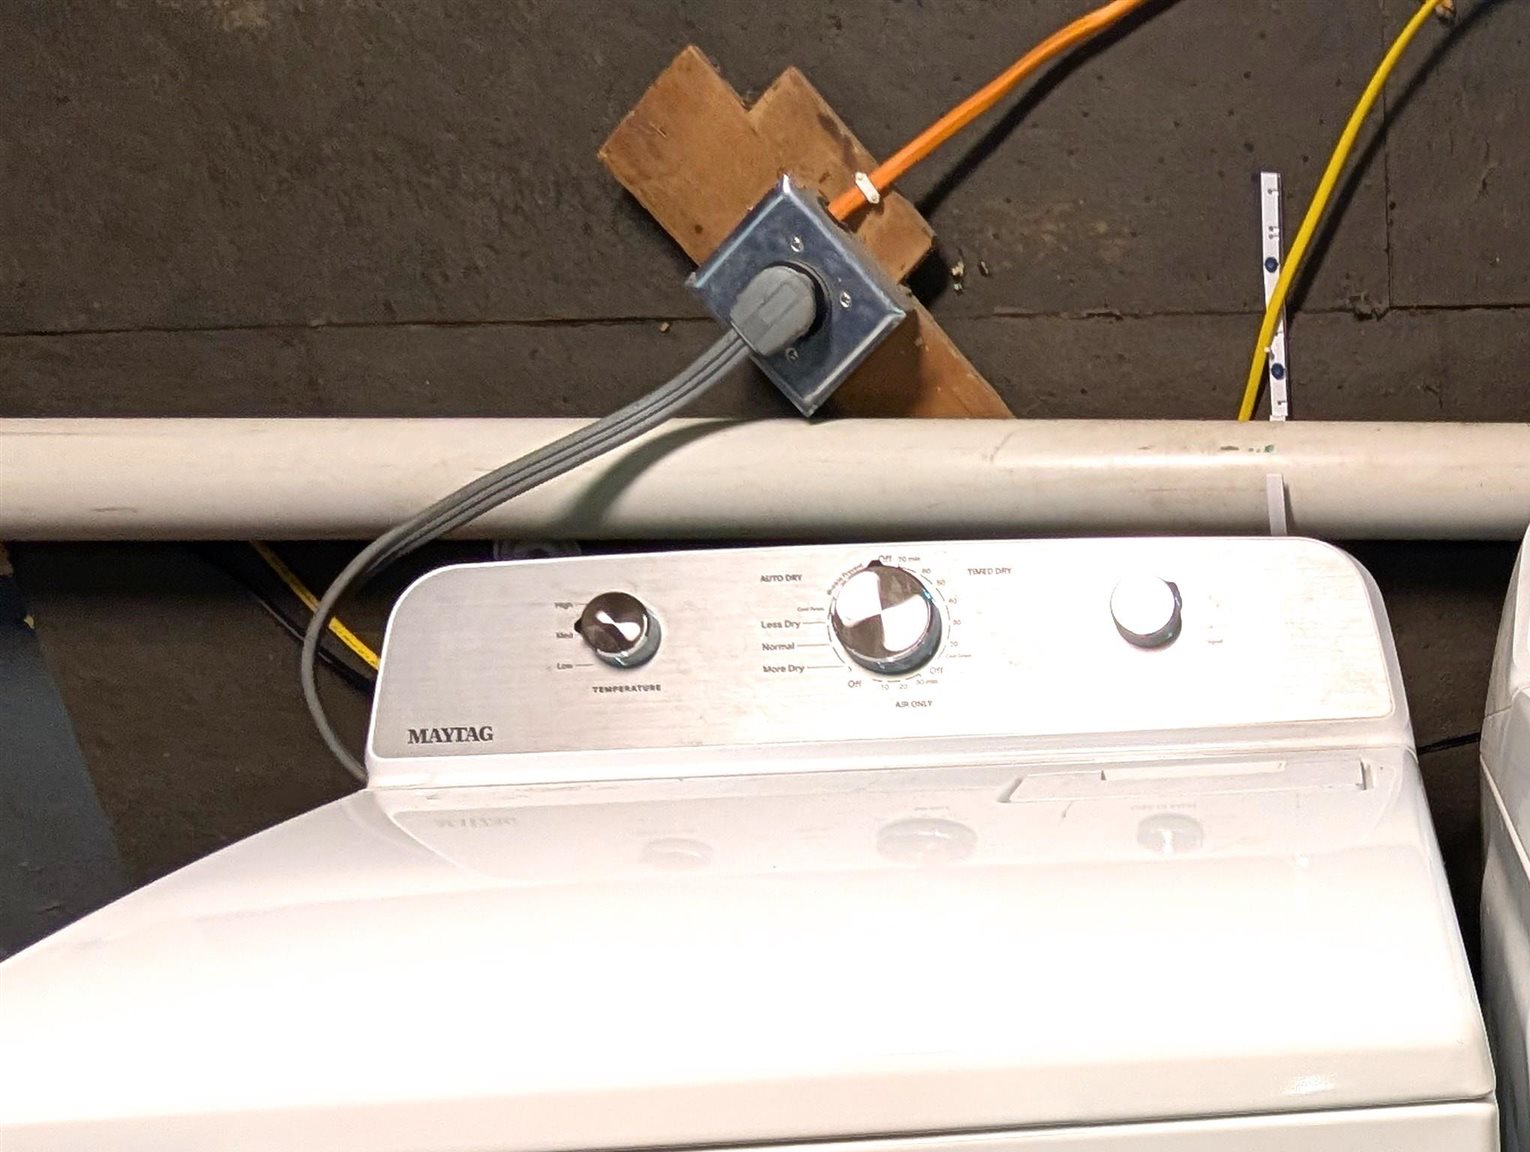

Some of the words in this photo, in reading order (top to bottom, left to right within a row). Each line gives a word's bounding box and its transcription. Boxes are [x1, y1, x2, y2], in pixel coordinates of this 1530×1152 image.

[785, 574, 802, 582] DRY
[761, 621, 783, 629] Less
[784, 620, 801, 629] Dry
[762, 643, 795, 651] Normal
[557, 662, 573, 670] Low
[763, 665, 786, 673] More
[788, 664, 805, 674] Dry
[592, 684, 661, 693] TEMPERATURE
[407, 726, 494, 745] MAYTAG
